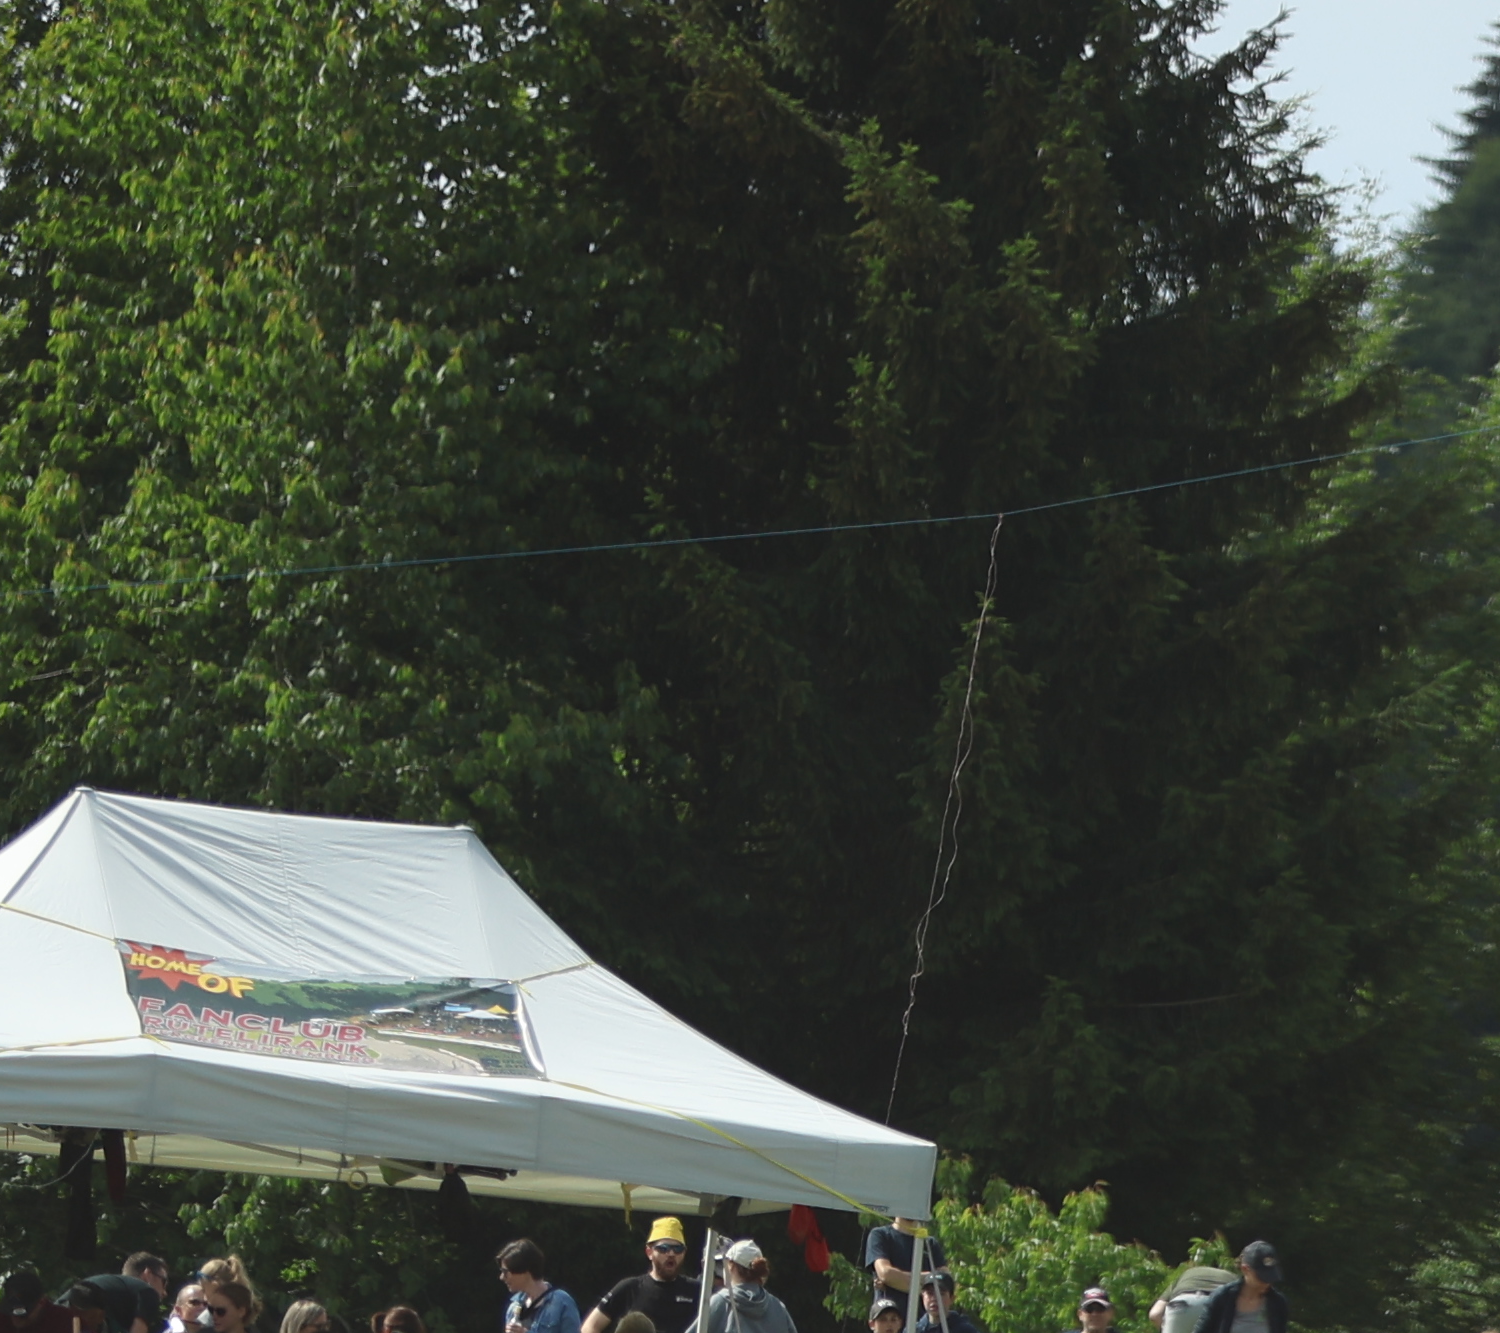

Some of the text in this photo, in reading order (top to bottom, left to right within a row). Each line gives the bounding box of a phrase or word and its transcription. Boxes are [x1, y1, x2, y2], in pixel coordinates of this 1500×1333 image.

[130, 953, 201, 975] HOME
[198, 973, 254, 998] OF
[138, 996, 366, 1042] FANCLUB
